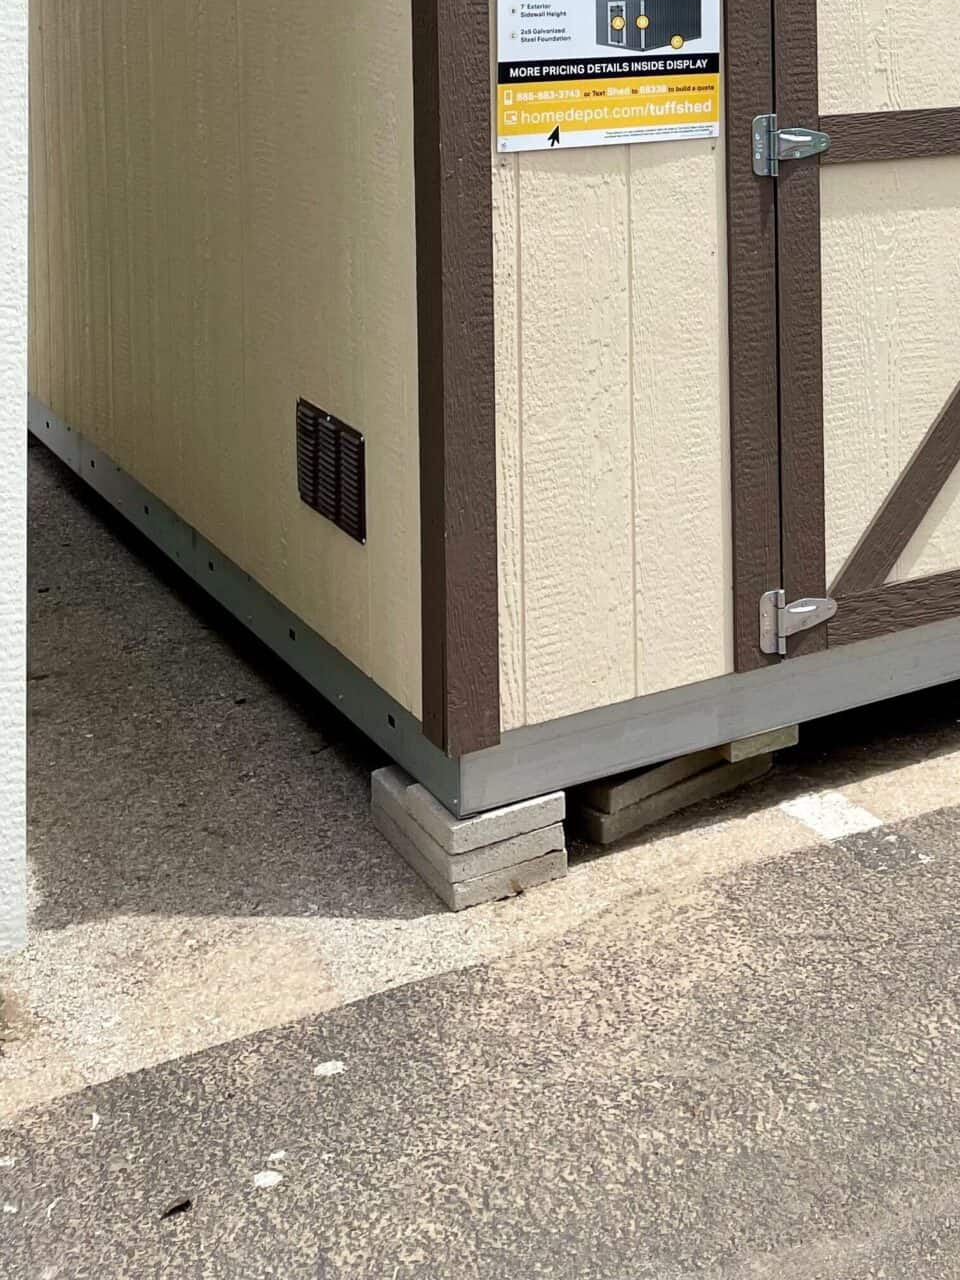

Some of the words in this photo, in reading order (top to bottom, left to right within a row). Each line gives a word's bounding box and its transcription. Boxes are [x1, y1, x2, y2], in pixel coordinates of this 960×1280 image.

[508, 66, 541, 79] MORE
[541, 63, 585, 78] PRICING
[585, 61, 630, 75] DETAILS
[630, 60, 666, 73] INSIDE
[665, 57, 708, 71] DISPLAY
[591, 89, 606, 97] Text
[631, 87, 639, 95] to
[675, 84, 691, 93] build
[696, 84, 715, 93] quote
[519, 98, 713, 125] homedepot.com/tuffshed
